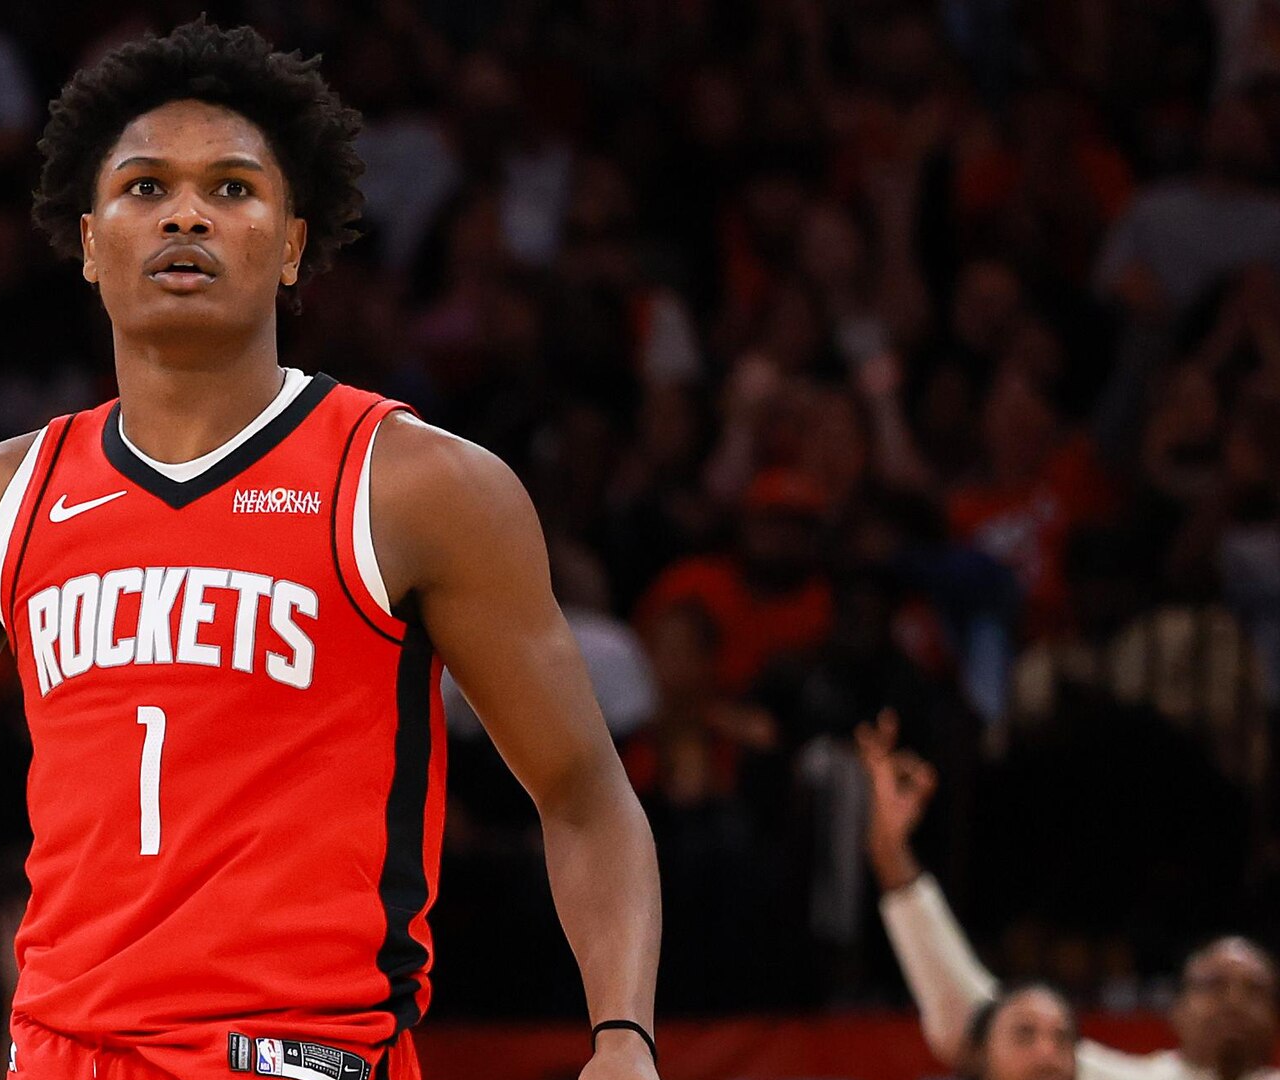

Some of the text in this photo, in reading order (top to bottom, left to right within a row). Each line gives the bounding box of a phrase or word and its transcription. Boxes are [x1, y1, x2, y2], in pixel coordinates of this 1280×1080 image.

[233, 488, 321, 503] MEMORIAL
[233, 500, 320, 514] HERMANN
[27, 566, 319, 698] ROCKETS
[136, 705, 166, 856] 1
